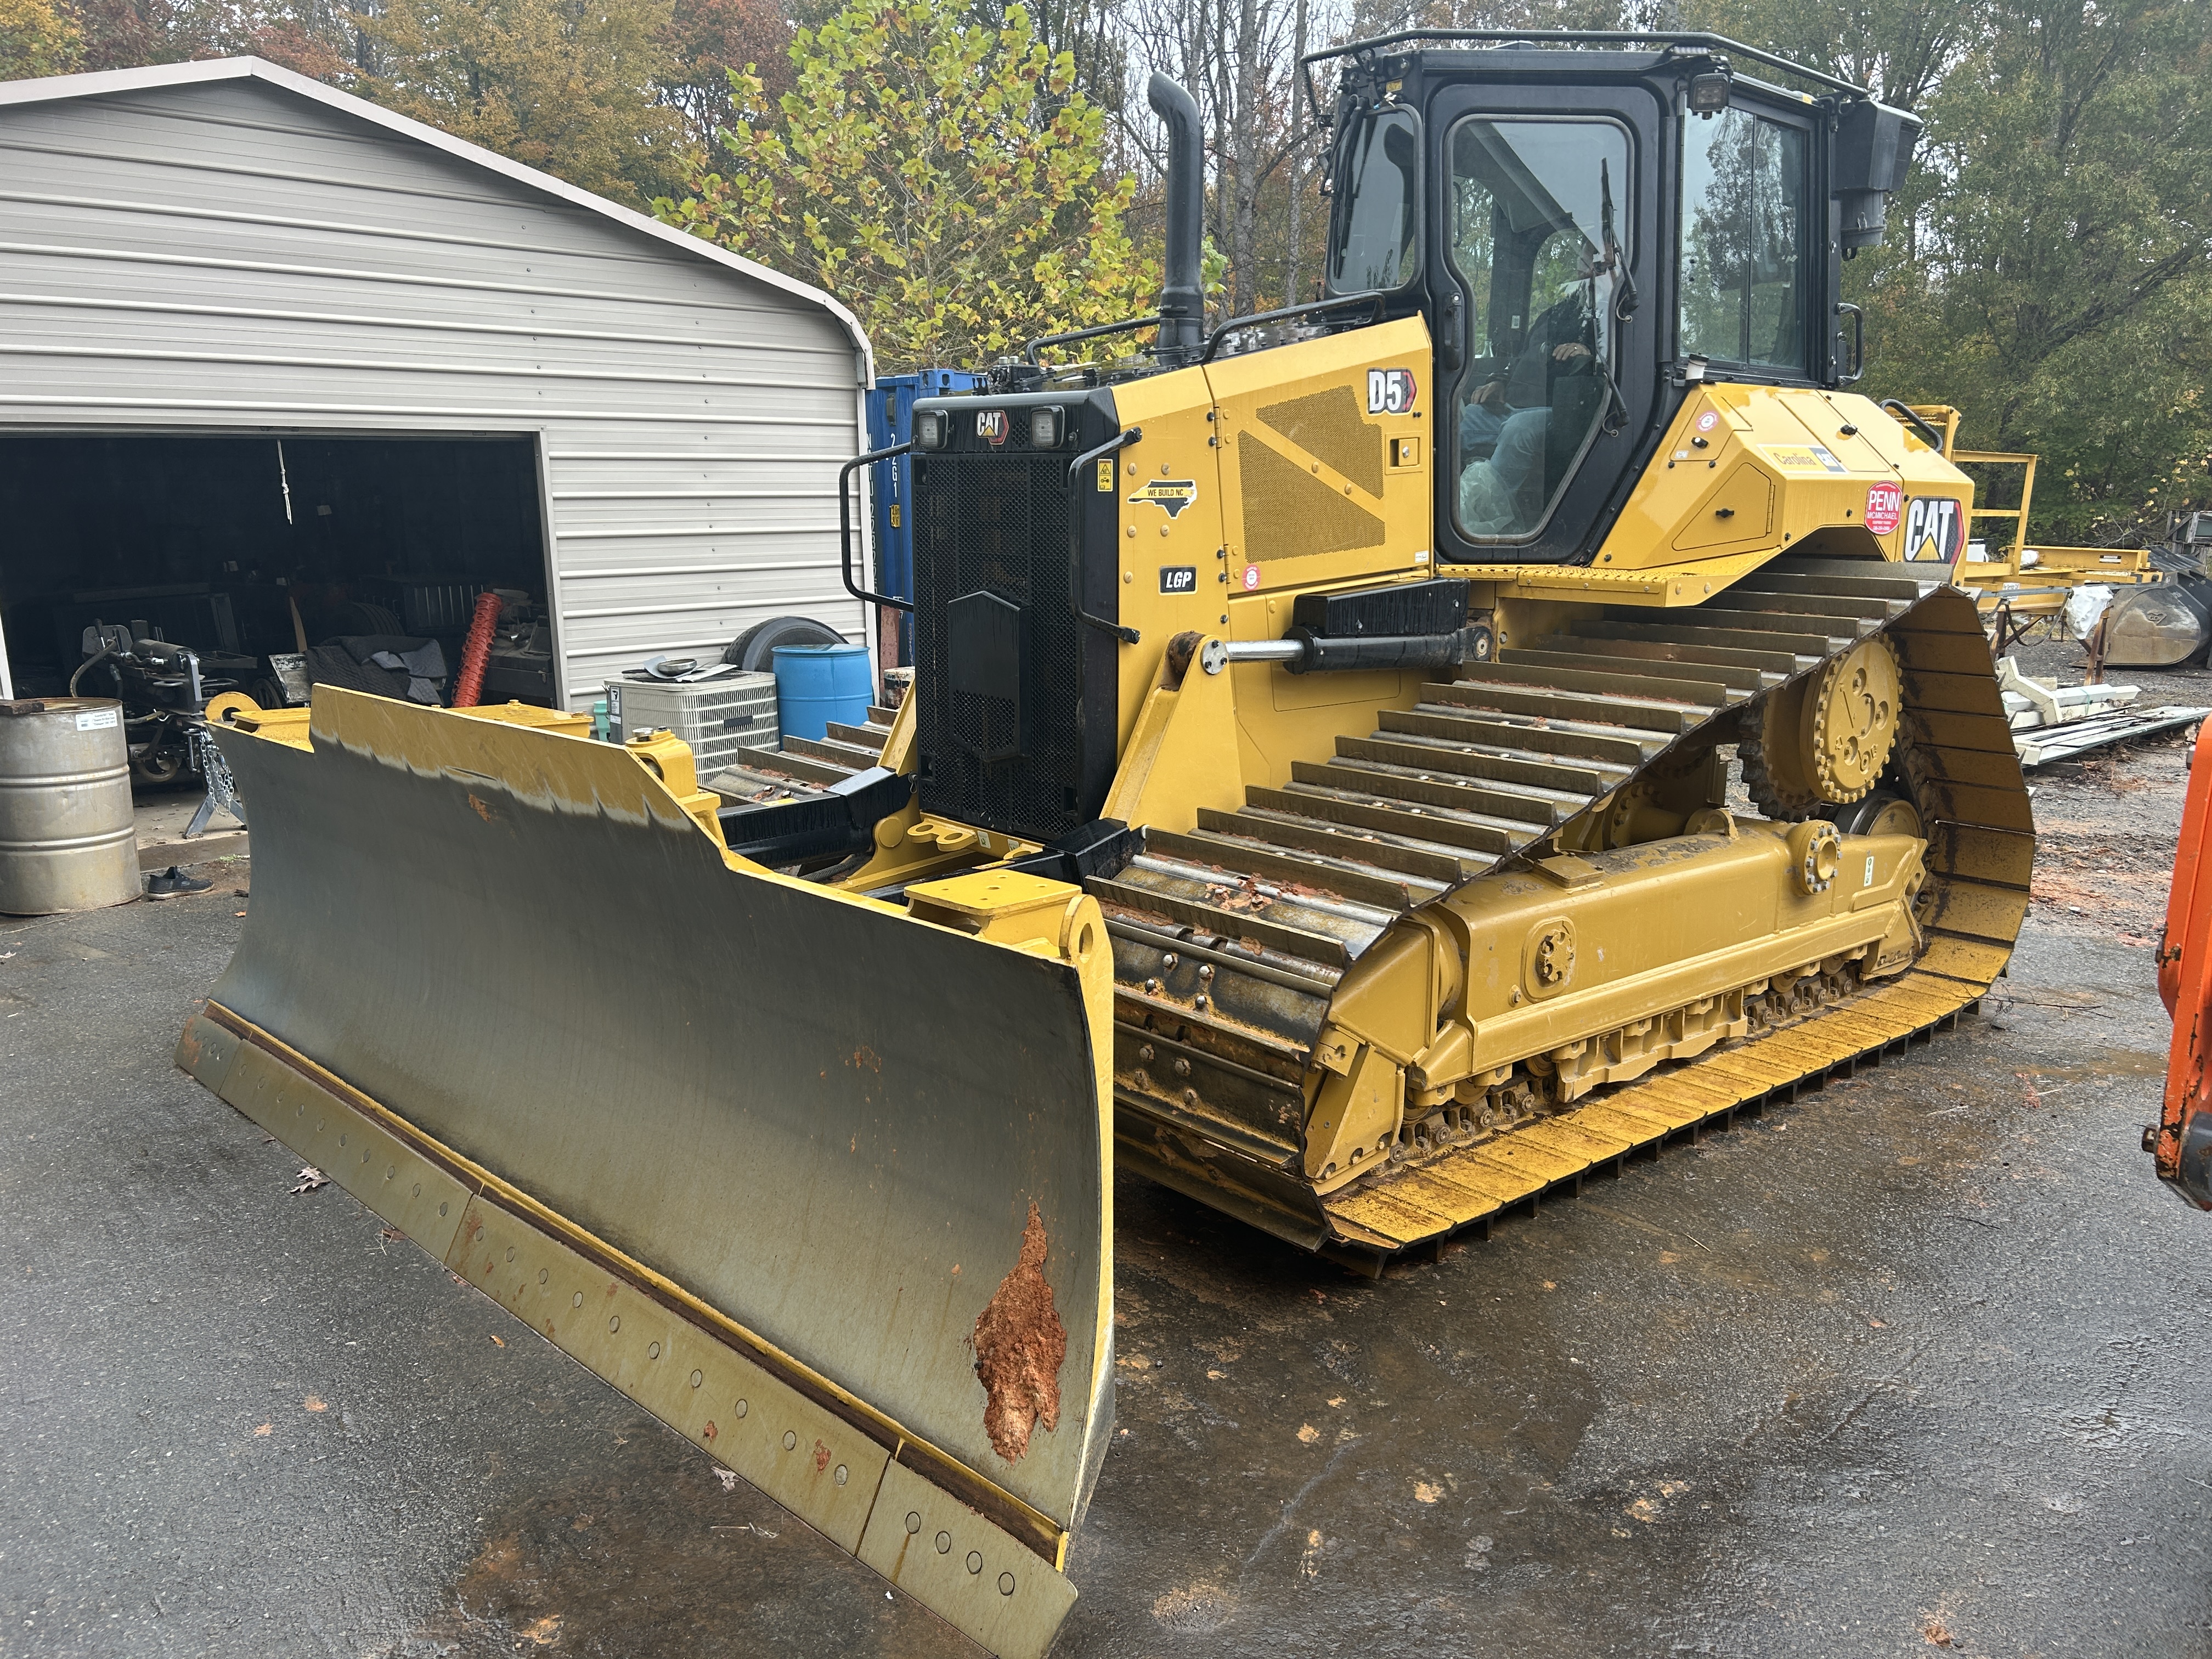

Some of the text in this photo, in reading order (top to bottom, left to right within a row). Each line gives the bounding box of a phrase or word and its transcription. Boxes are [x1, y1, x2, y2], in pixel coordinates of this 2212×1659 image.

[1369, 371, 1402, 411] D5
[977, 412, 1001, 436] CAT
[1773, 452, 1817, 466] Carolina
[1867, 490, 1900, 511] PENN
[1867, 511, 1898, 520] MCMICHAEL
[1905, 500, 1954, 561] CAT
[1166, 572, 1192, 589] LGP
